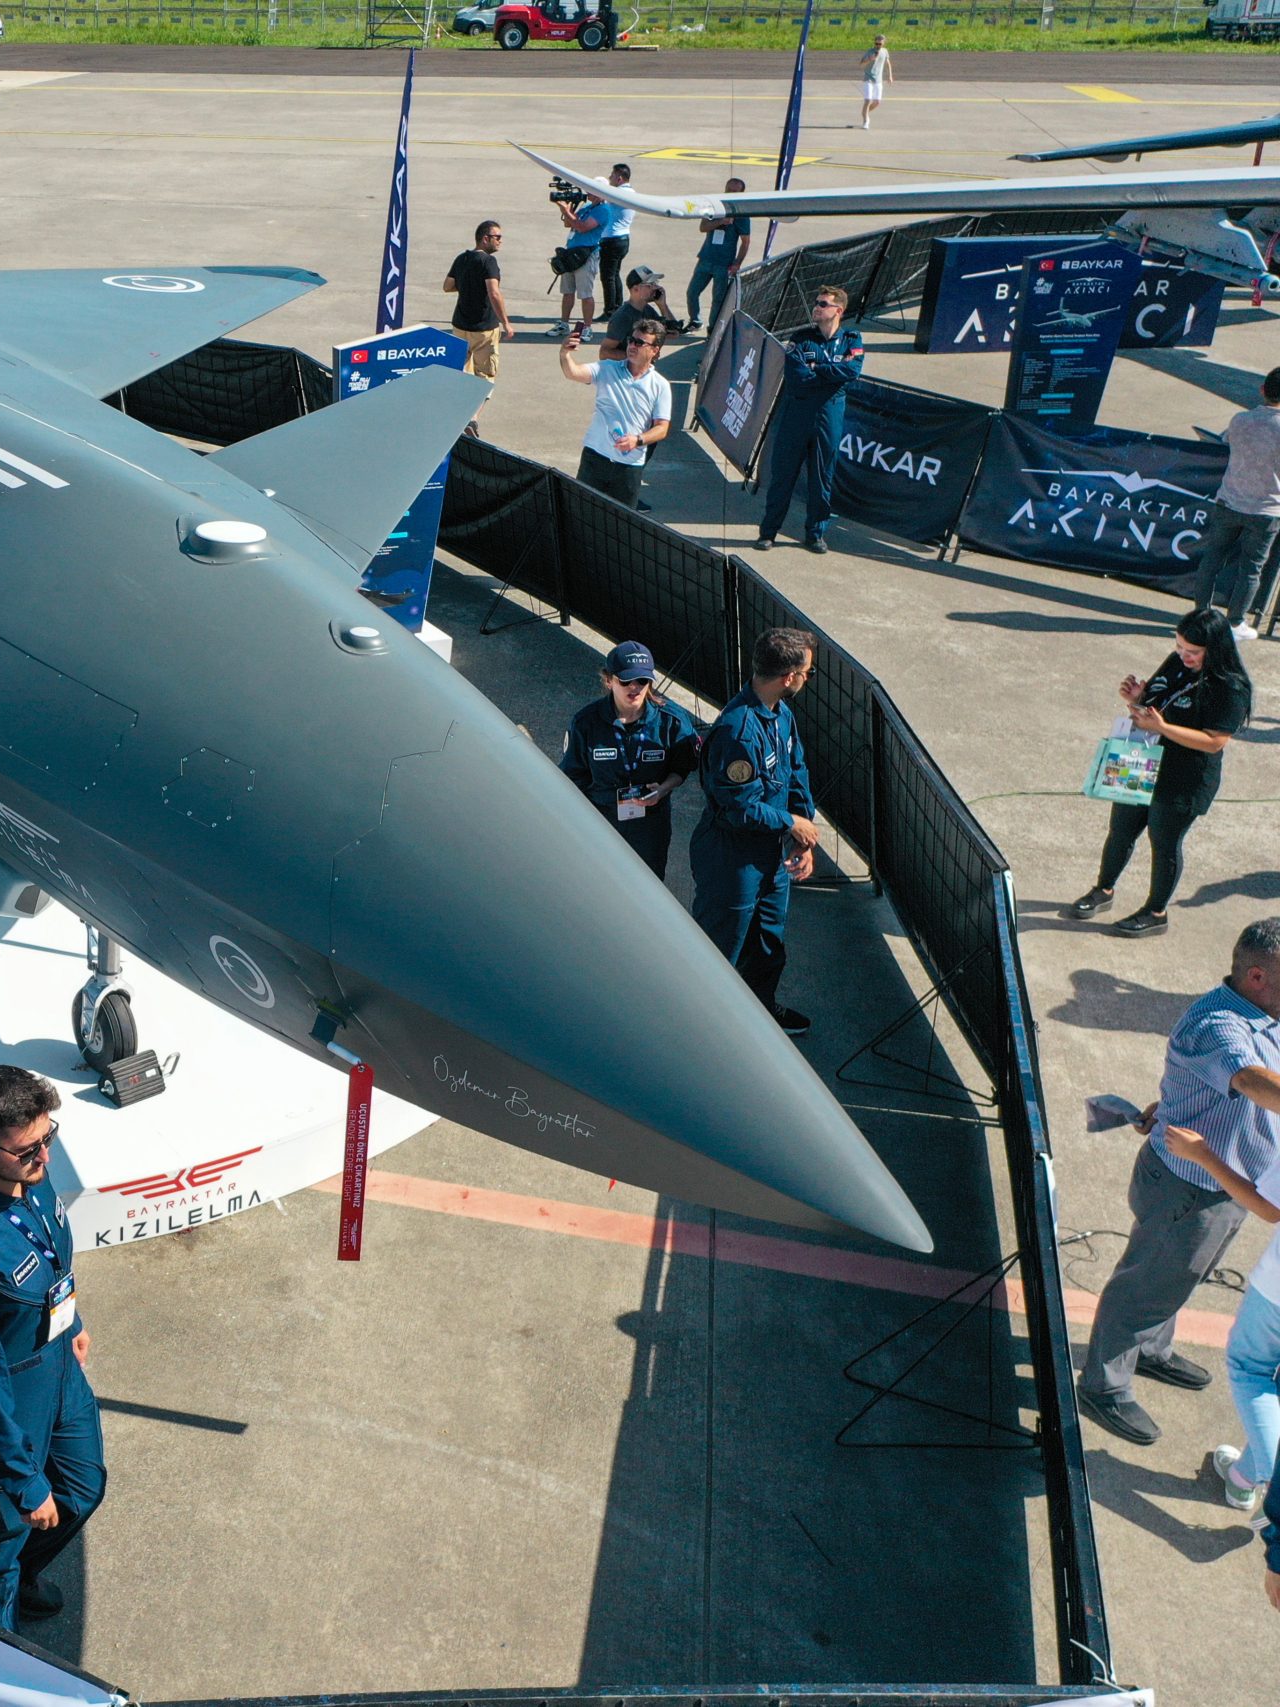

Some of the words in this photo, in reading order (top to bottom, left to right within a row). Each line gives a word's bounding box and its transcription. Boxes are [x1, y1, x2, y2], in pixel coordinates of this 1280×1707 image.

[383, 115, 407, 333] AYKAR
[1071, 259, 1124, 270] BAYKAR
[387, 346, 446, 360] BAYKAR
[839, 432, 942, 486] AYKAR
[1048, 482, 1208, 526] BAYRAKTAR
[1008, 498, 1203, 561] AKINC
[347, 1109, 357, 1141] REMOVE
[357, 1103, 367, 1140] UÇUŞTAN
[505, 1086, 597, 1138] Bayraktar
[345, 1143, 355, 1173] BEFORE
[355, 1141, 366, 1163] ÖNCE
[126, 1182, 237, 1219] BAYRAKTAR
[344, 1175, 353, 1202] FLIGHT
[352, 1164, 363, 1208] ÇIKARTINIZ
[95, 1189, 262, 1247] KIZILELMA
